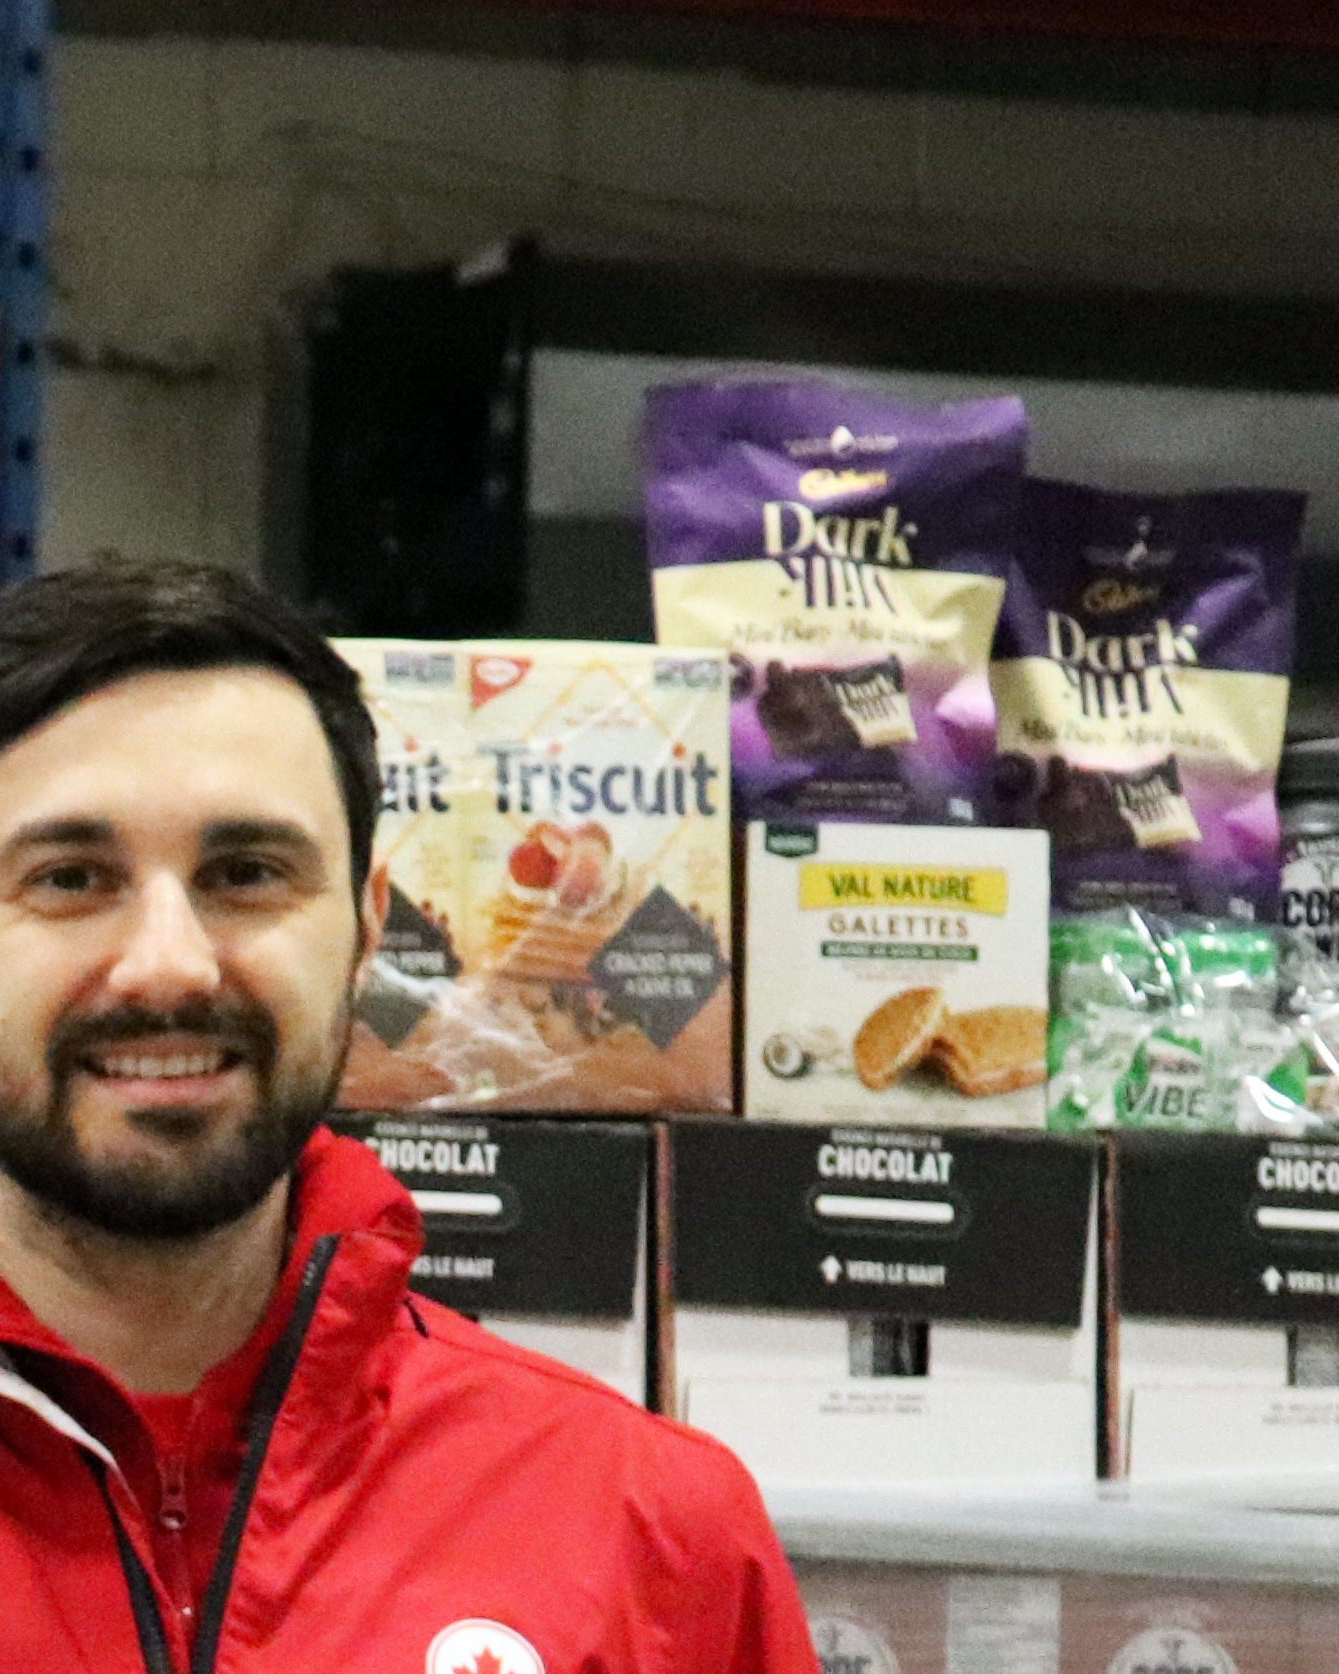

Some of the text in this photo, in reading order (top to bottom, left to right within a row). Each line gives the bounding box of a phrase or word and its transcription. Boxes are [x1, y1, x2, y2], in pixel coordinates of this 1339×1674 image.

[763, 501, 920, 567] Dark
[1047, 610, 1200, 674] Dark
[476, 741, 718, 816] Triscuit
[828, 872, 976, 903] VAL NATURE
[828, 911, 970, 939] GALETTES
[1123, 1083, 1206, 1118] VIBE
[816, 1143, 954, 1185] CHOCOLAT
[1257, 1155, 1339, 1193] CHOCO
[845, 1258, 947, 1286] VERS LE HAUT
